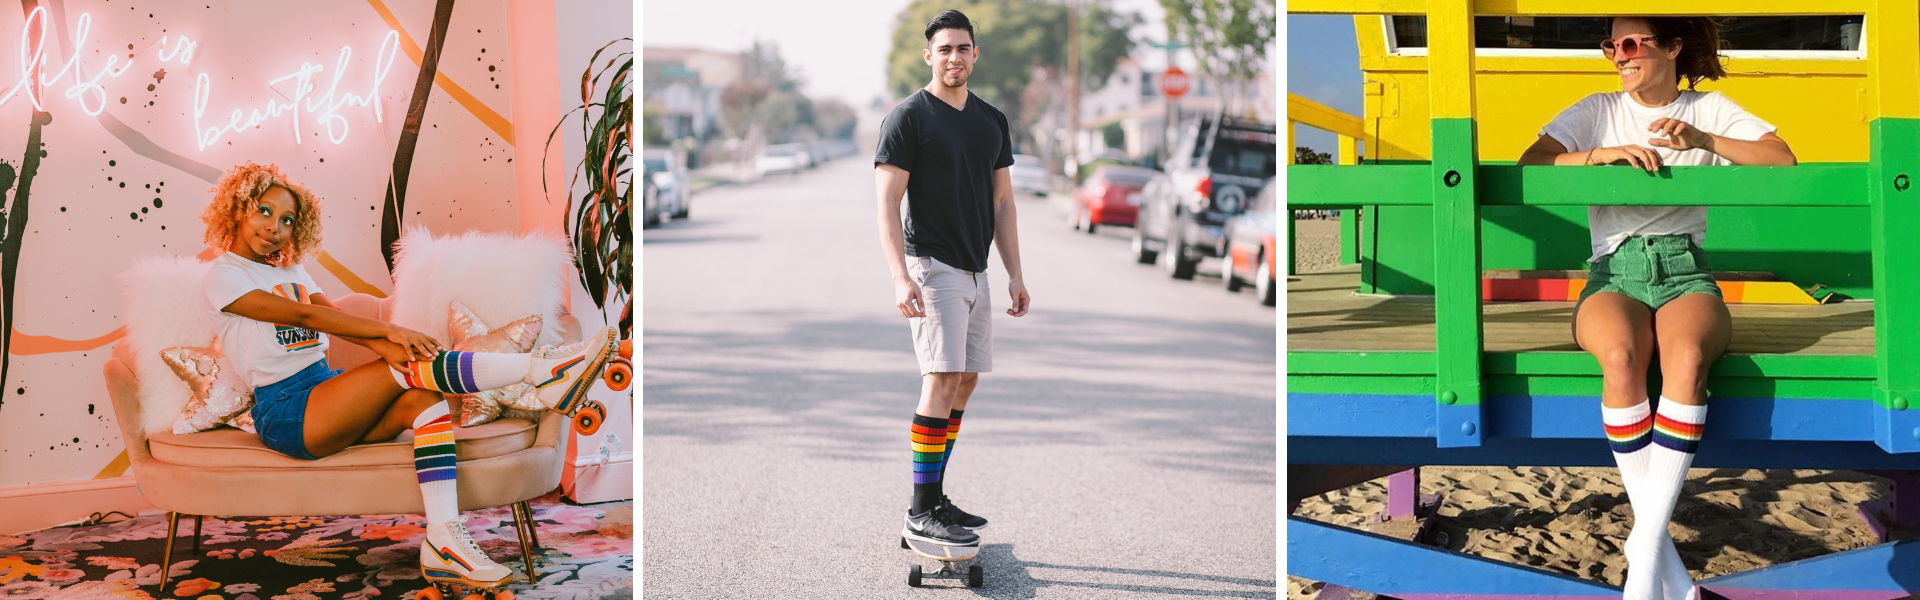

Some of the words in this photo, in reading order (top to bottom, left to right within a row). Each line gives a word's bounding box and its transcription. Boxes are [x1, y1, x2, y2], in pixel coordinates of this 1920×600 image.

[0, 6, 133, 116] life
[158, 34, 198, 64] is
[194, 29, 400, 151] beautiful
